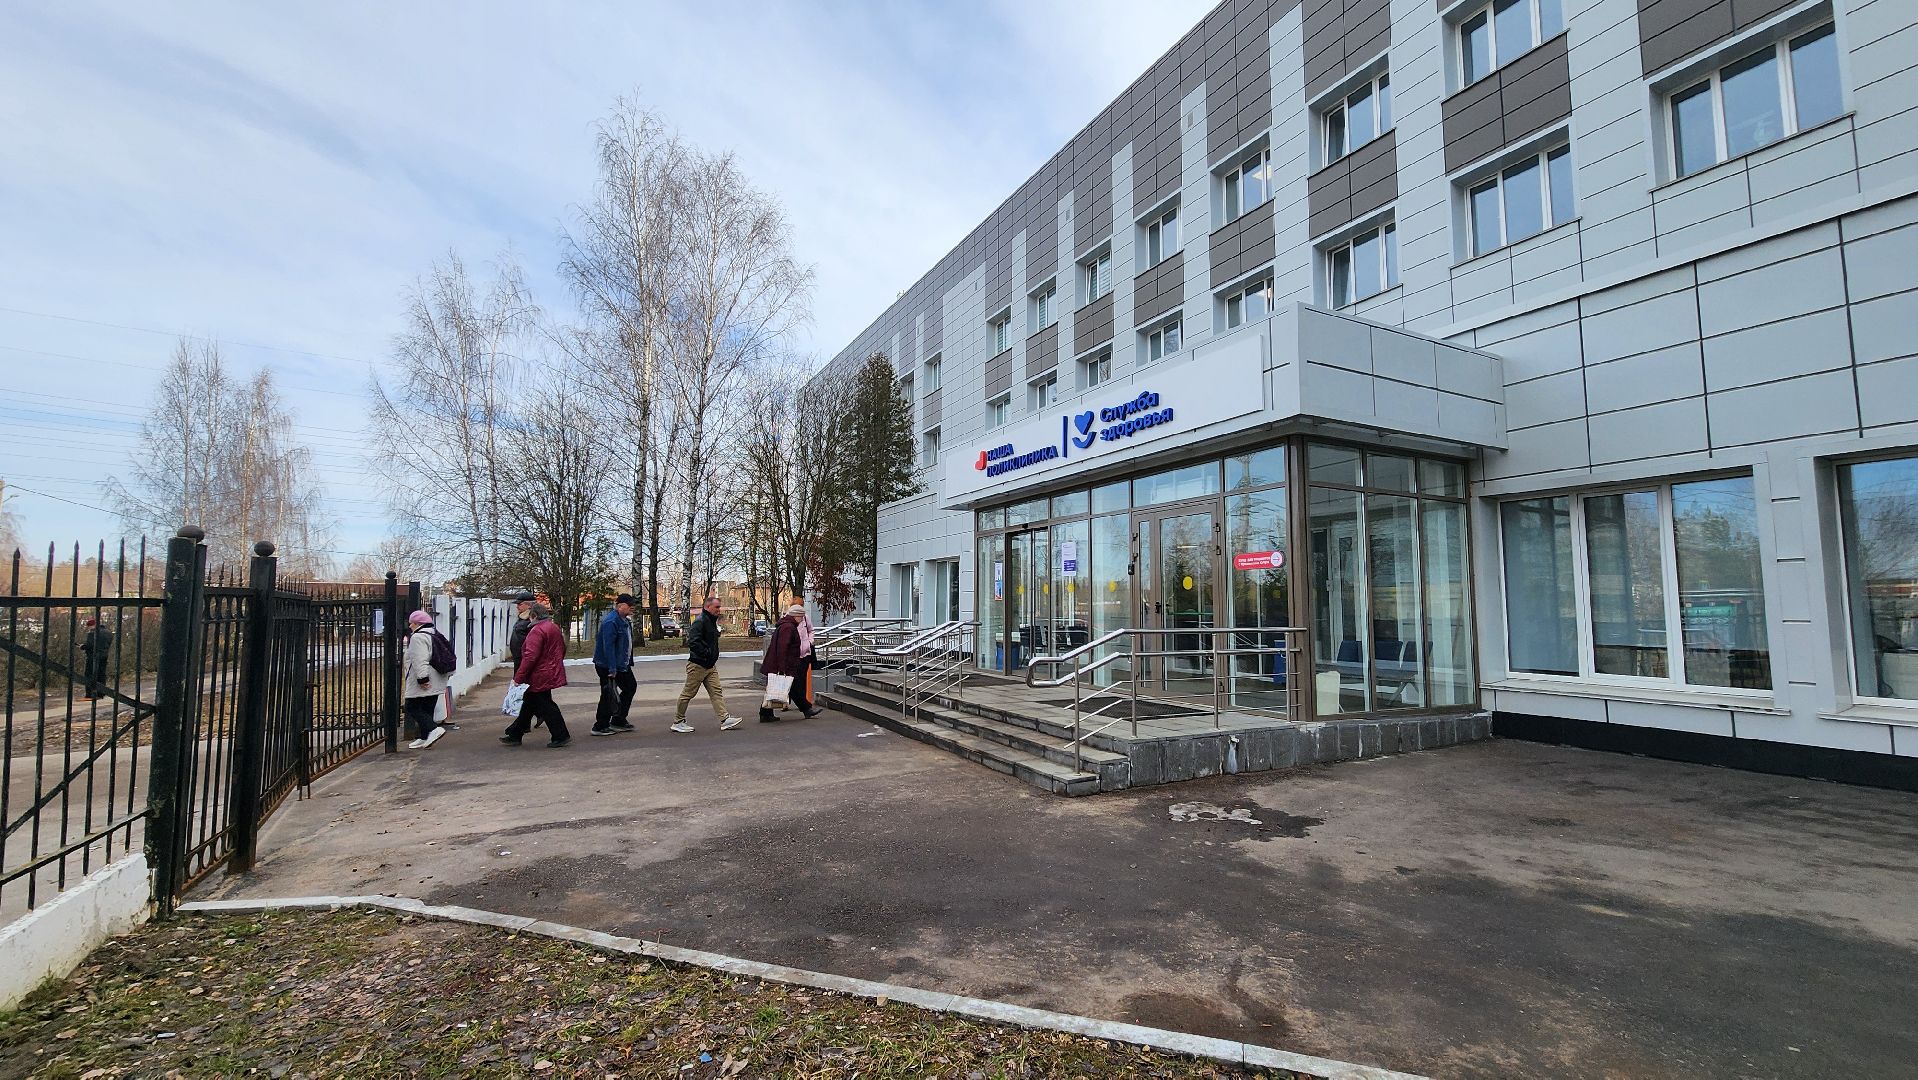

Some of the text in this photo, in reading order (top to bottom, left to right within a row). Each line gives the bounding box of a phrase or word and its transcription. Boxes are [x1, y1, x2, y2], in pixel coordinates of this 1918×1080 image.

[1100, 391, 1159, 422] Служба
[1100, 408, 1173, 441] здоровья
[987, 443, 1014, 461] НАША
[987, 445, 1058, 477] ПОЛИКЛИНИКА
